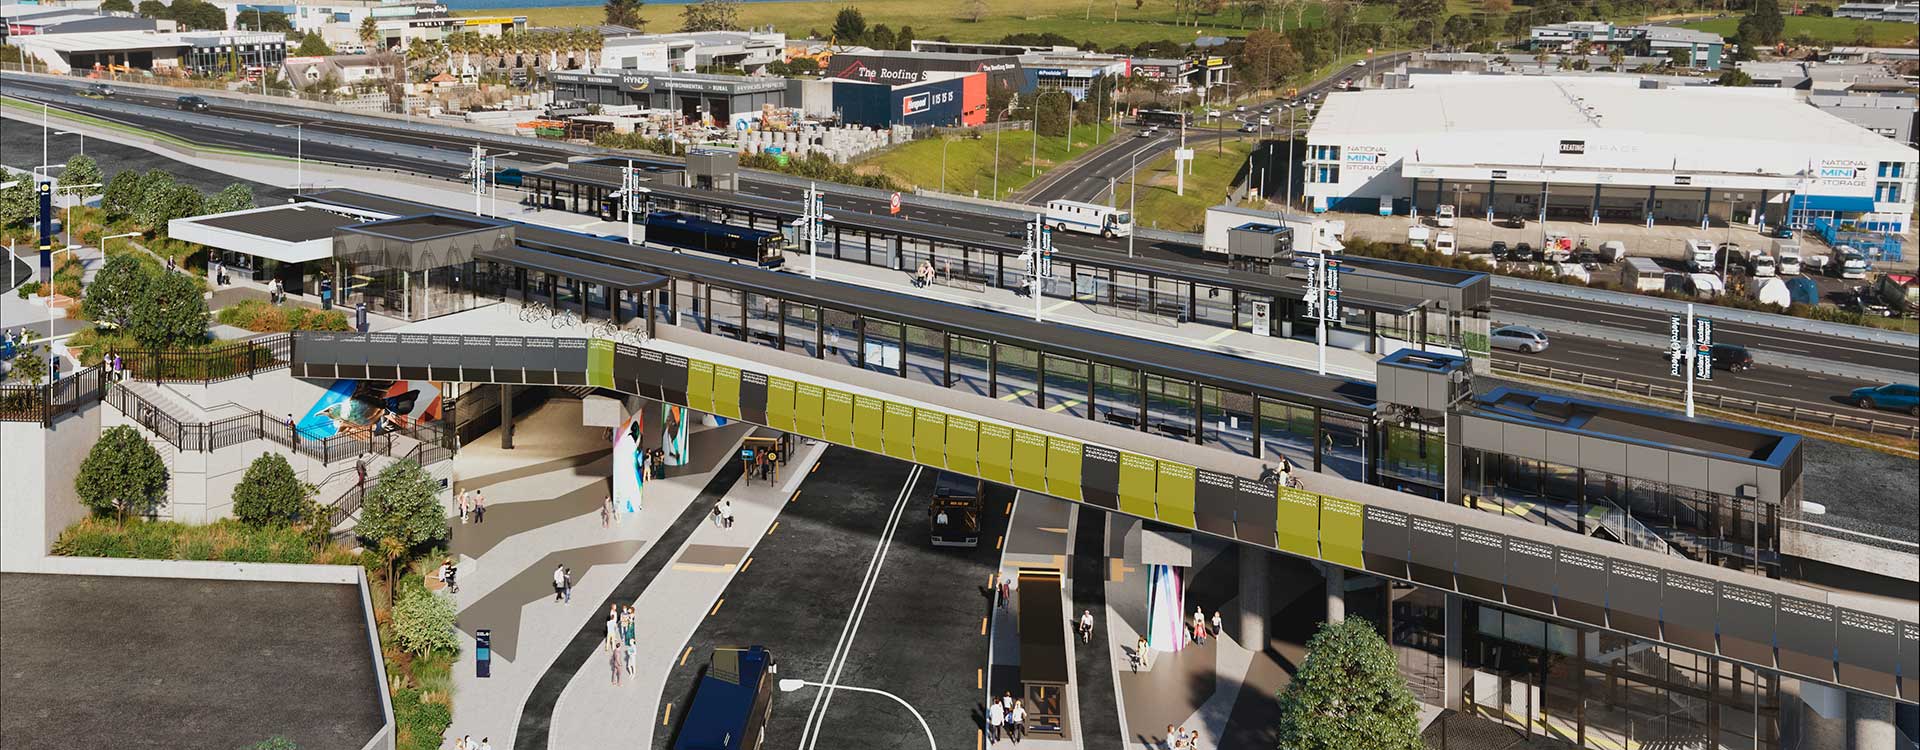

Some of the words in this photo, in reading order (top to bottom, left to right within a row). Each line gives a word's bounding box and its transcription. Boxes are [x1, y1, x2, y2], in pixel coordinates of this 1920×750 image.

[623, 75, 650, 84] HYNDS
[859, 66, 876, 78] The
[881, 68, 918, 81] Roofing
[1560, 143, 1585, 152] CREATING
[1820, 168, 1852, 177] MINI
[1671, 316, 1680, 340] Metro
[1671, 350, 1680, 375] Metro
